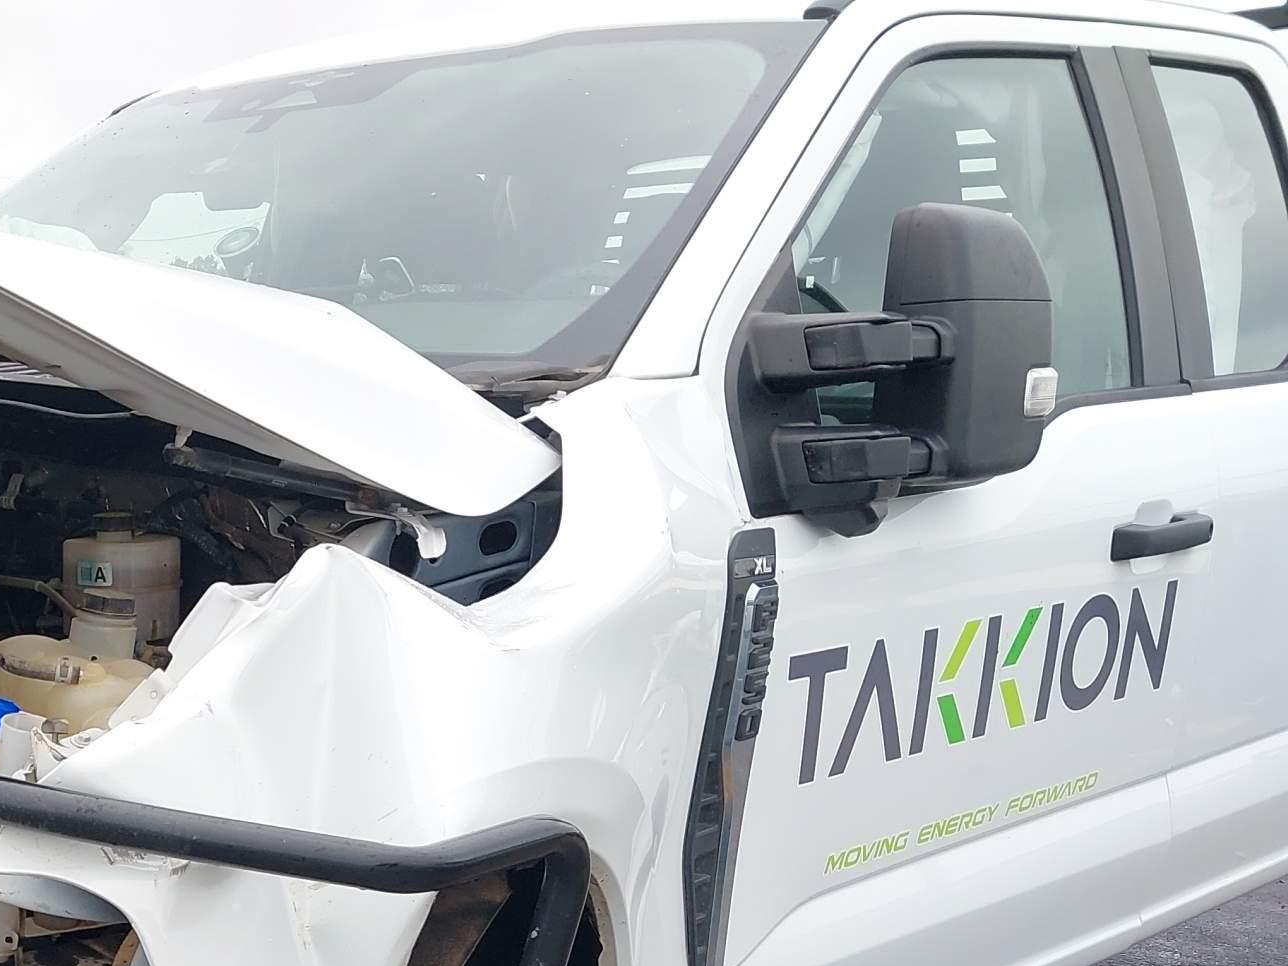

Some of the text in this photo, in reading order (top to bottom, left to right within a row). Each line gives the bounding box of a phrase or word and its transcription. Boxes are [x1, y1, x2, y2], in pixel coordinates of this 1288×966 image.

[94, 566, 107, 583] A
[753, 557, 773, 575] XL
[788, 579, 1178, 785] TAKKION
[824, 771, 1099, 875] MOVING ENERGY FORWARD
